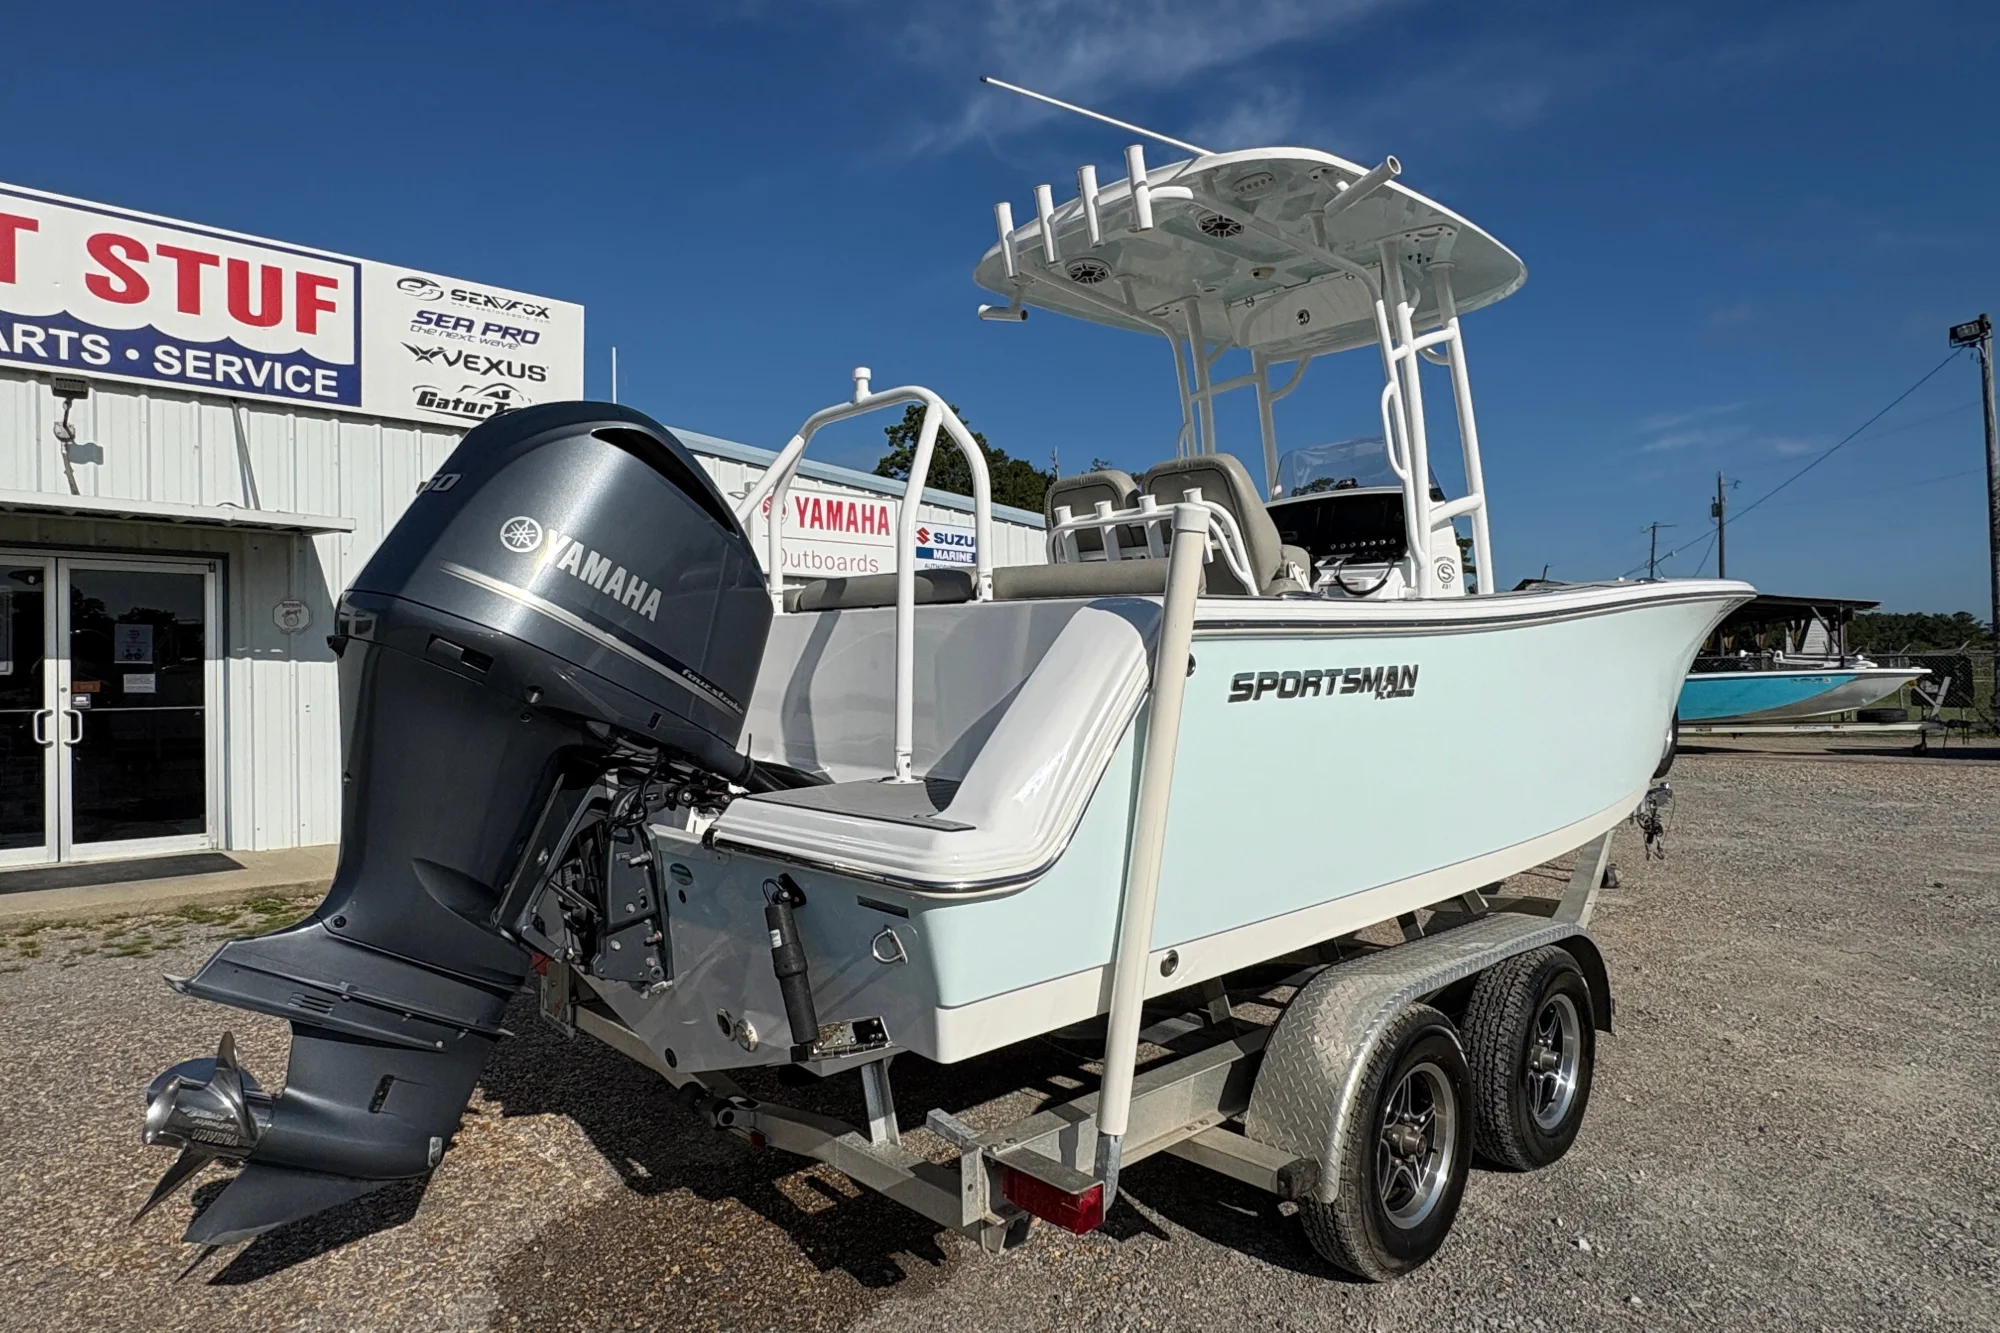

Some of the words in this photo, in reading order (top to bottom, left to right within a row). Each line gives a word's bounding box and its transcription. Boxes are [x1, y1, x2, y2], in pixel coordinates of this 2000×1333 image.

[85, 233, 339, 335] STUF
[410, 324, 437, 335] the
[439, 331, 477, 343] next
[480, 337, 519, 351] wave
[411, 310, 475, 333] SEA
[481, 322, 540, 346] PRO
[153, 345, 338, 398] SERVICE
[442, 349, 547, 382] VEXUS
[795, 496, 890, 536] YAMAHA
[933, 532, 977, 547] SUZU
[933, 549, 973, 562] MARINE
[543, 528, 662, 622] YAMAHA
[1228, 664, 1418, 703] SPORTSMAN
